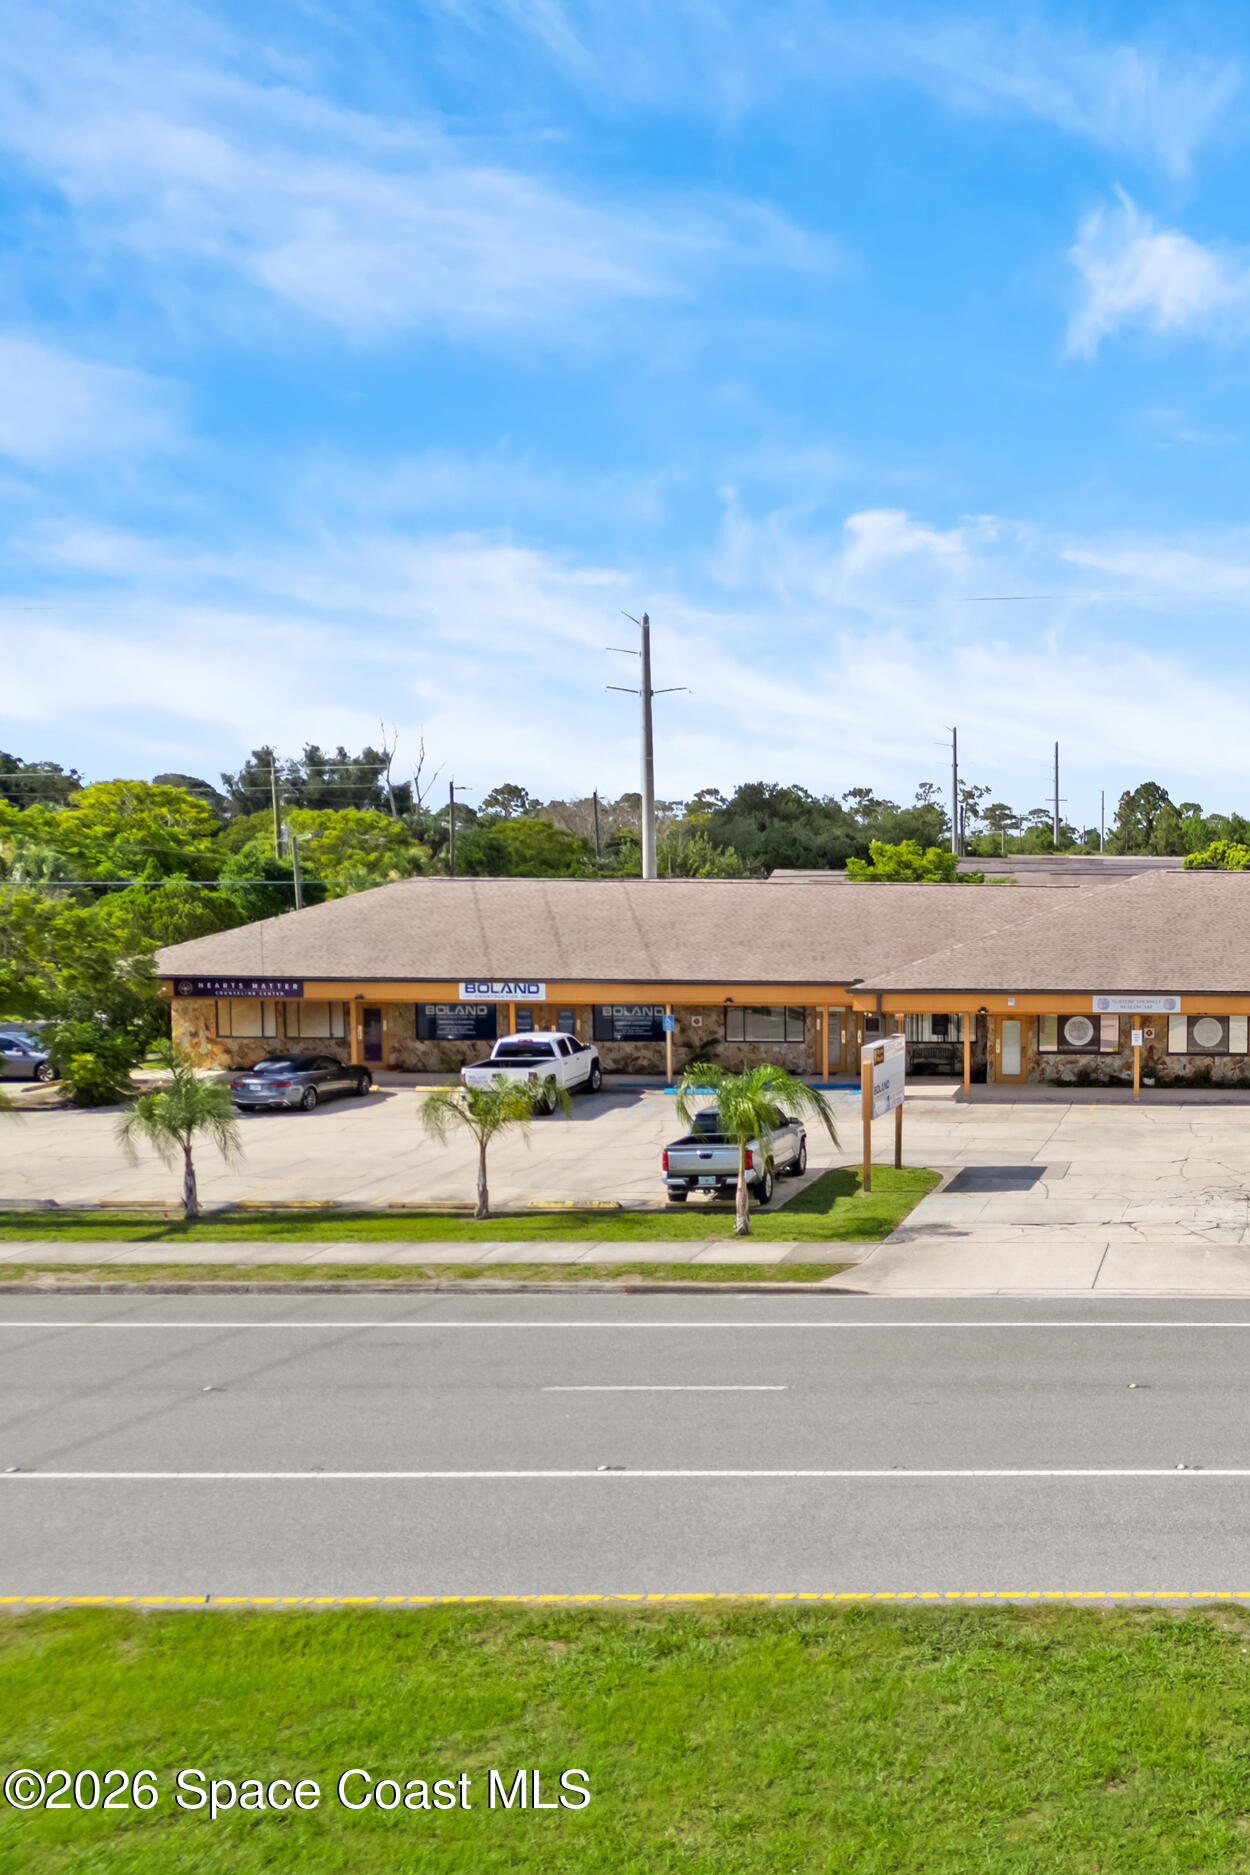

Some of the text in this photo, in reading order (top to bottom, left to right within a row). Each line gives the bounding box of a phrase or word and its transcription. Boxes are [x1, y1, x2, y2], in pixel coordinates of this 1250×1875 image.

[465, 983, 540, 994] BOLAND
[425, 1005, 488, 1015] BOLAND
[602, 1006, 665, 1017] BOLAND
